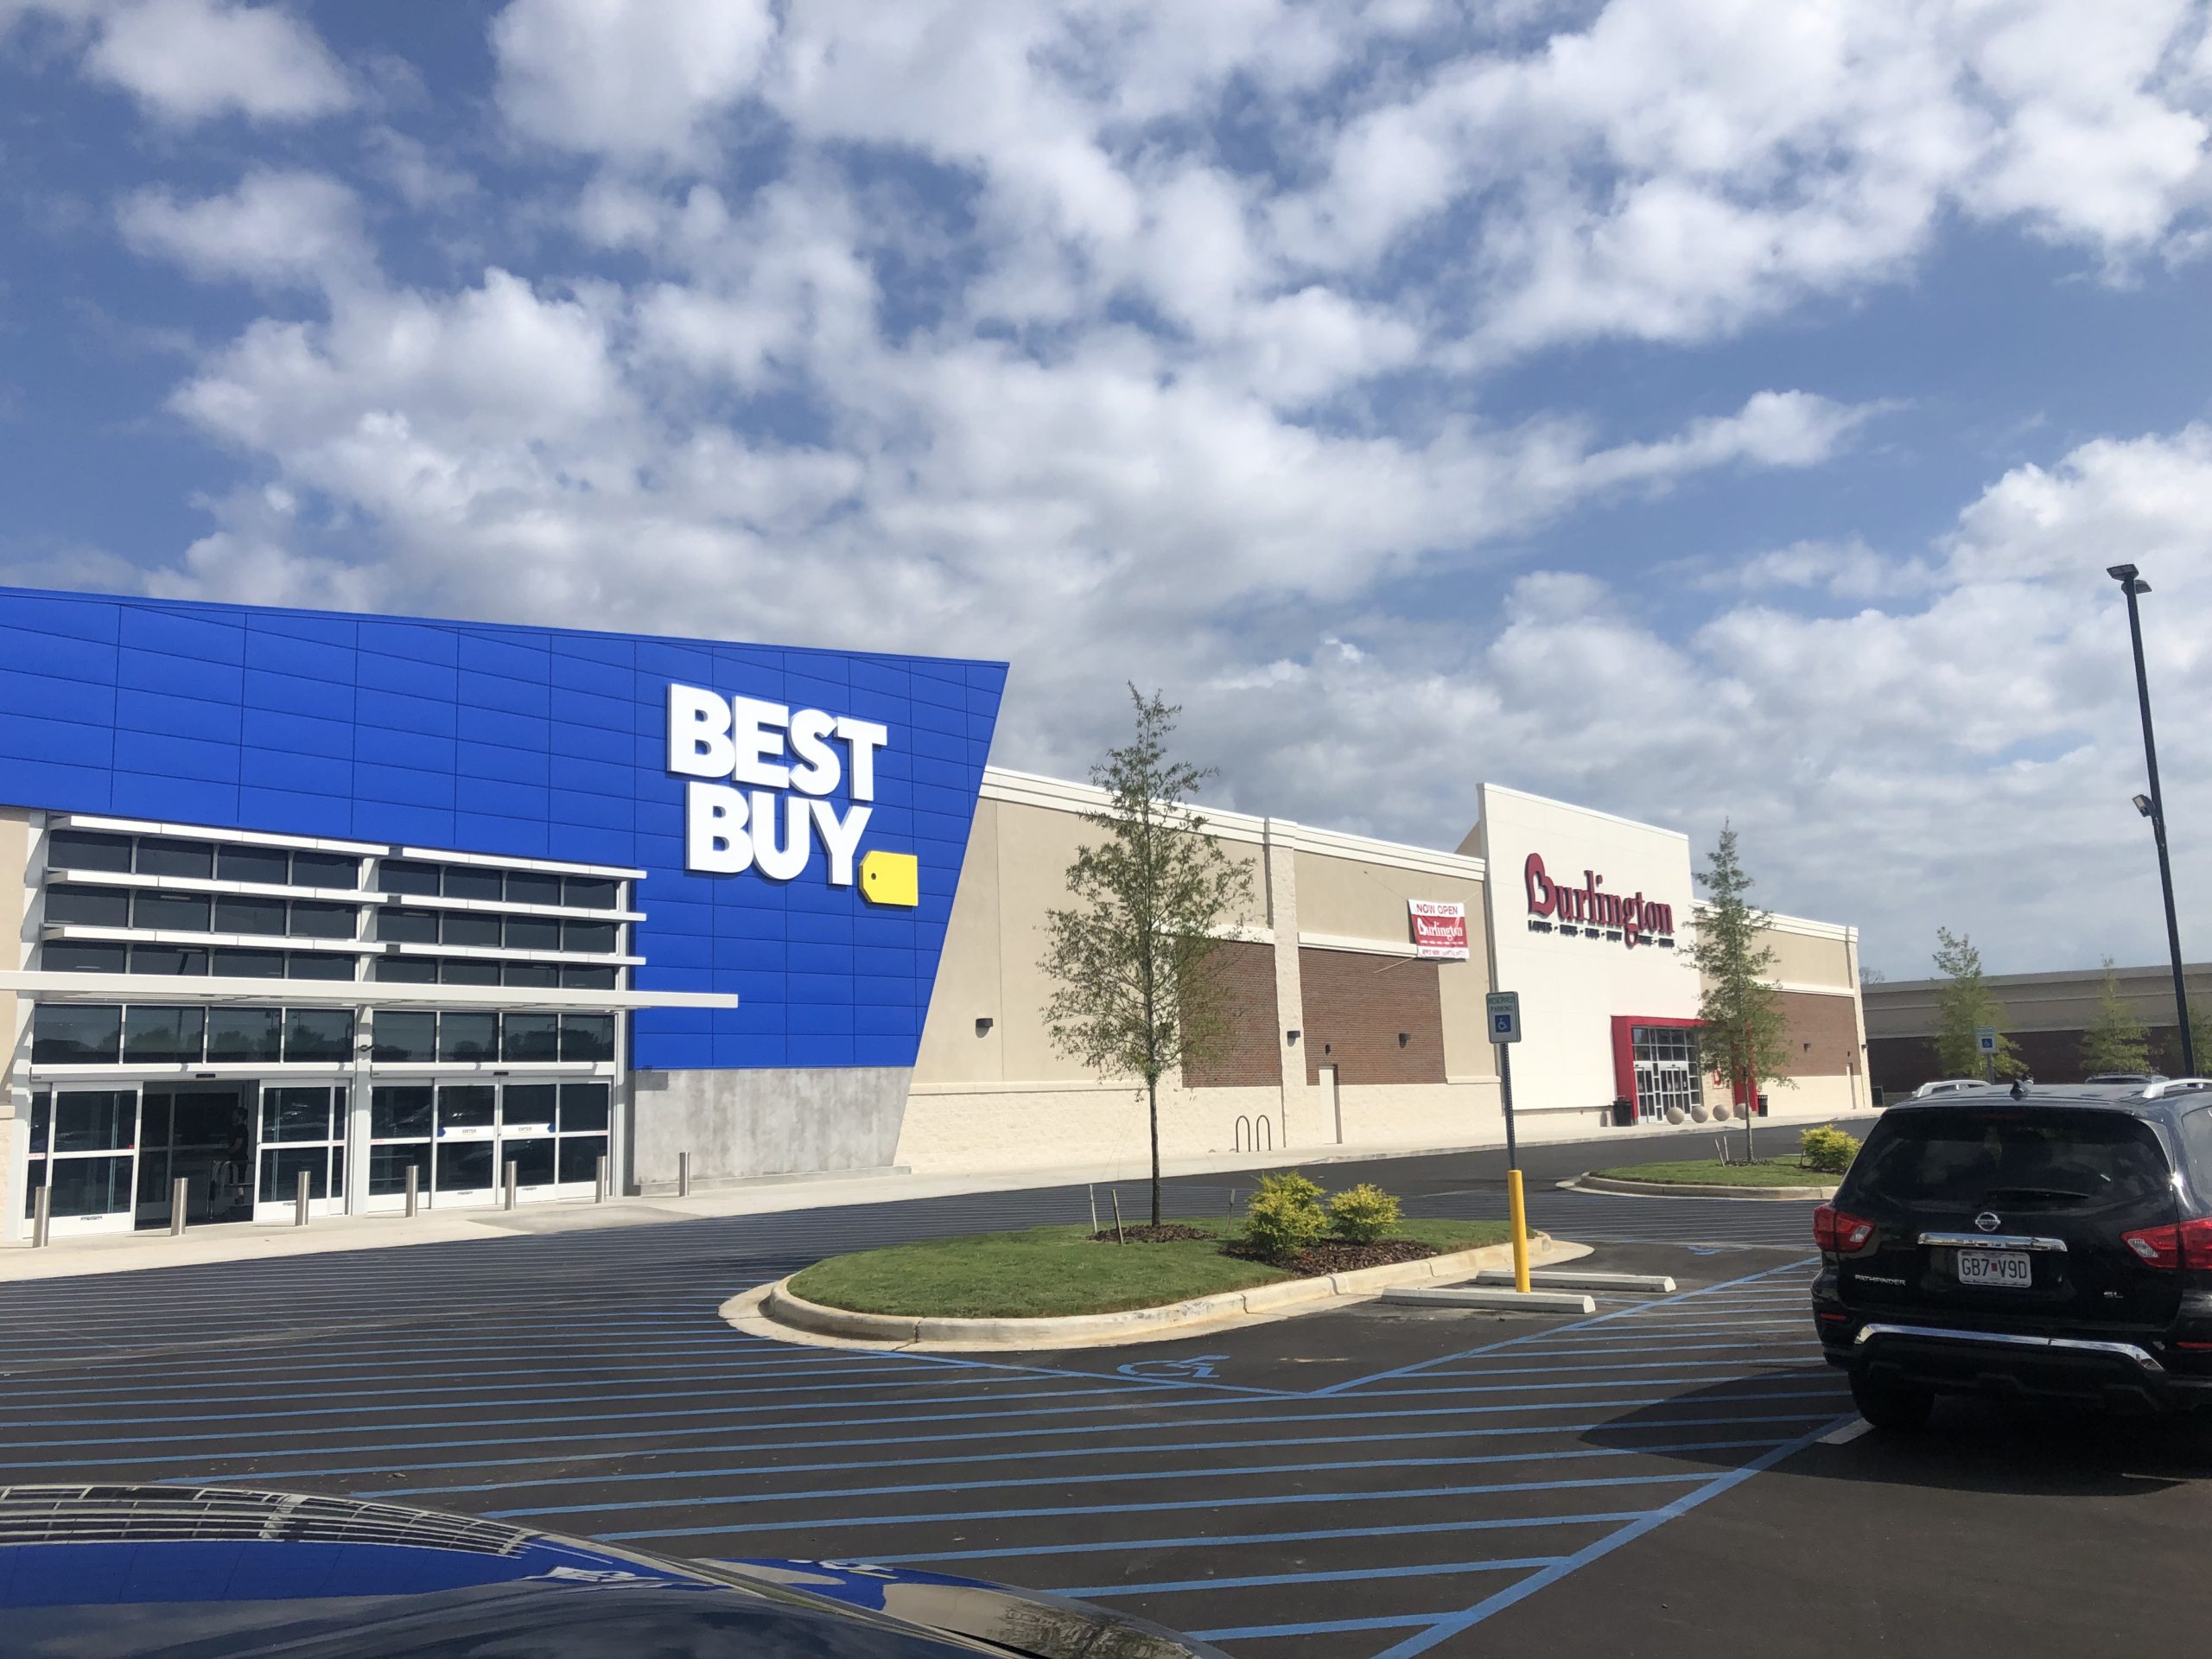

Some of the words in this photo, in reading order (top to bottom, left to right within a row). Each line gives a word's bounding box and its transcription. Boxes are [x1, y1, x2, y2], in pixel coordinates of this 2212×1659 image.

[667, 683, 887, 802] BEST
[685, 780, 874, 886] BUY
[1416, 904, 1435, 914] NOW
[1437, 905, 1458, 915] OPEN
[1524, 853, 1675, 949] Burlington
[1417, 917, 1463, 942] Burlington
[1854, 1274, 1907, 1287] PATHFINDER
[1961, 1258, 1990, 1277] GB7
[1998, 1259, 2027, 1279] V9D
